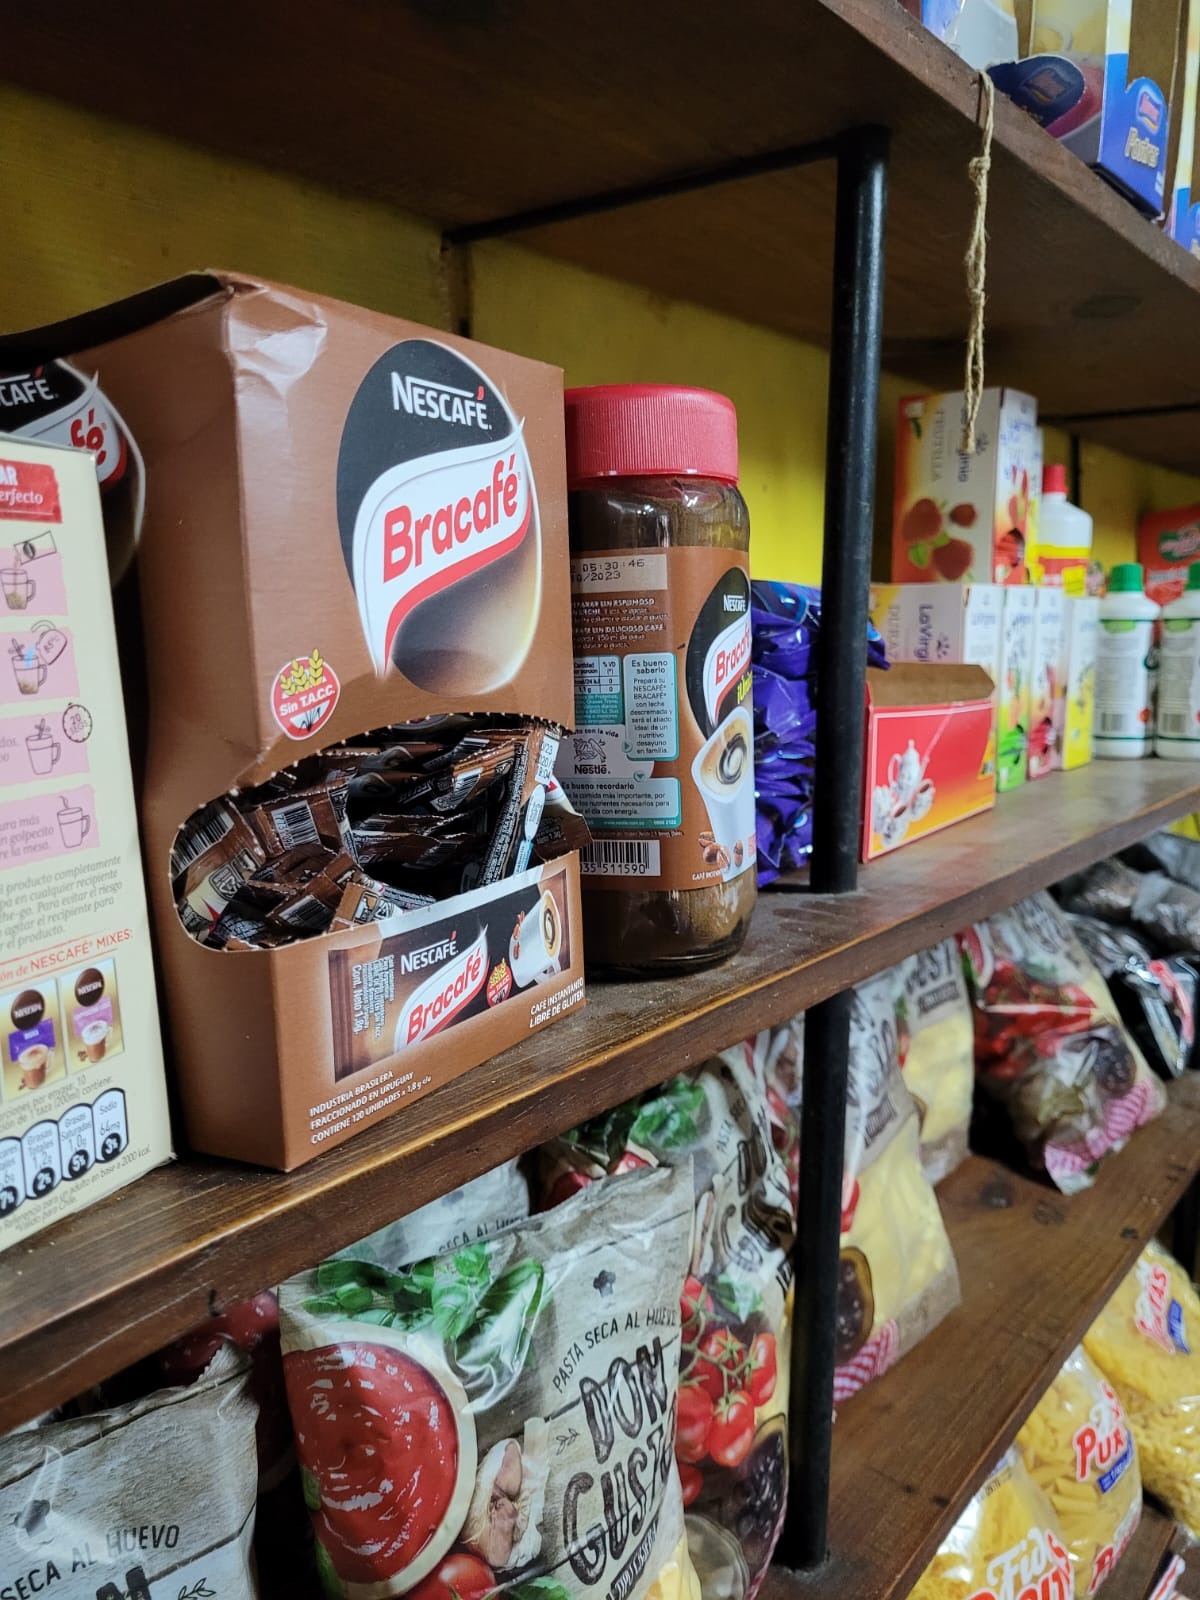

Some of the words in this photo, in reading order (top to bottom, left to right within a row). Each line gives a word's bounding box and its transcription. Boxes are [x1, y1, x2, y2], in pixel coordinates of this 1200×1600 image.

[391, 371, 488, 430] NESCAFÉ
[383, 454, 519, 584] Bracafé
[631, 660, 641, 668] Es
[642, 659, 668, 667] bueno
[636, 666, 666, 675] saberlo
[279, 701, 299, 717] Sin
[571, 782, 594, 790] bueno
[596, 782, 635, 790] recordarlo
[654, 793, 666, 801] por
[601, 808, 614, 816] con
[54, 855, 121, 881] completamente
[602, 863, 646, 875] 511590
[400, 930, 457, 976] NESCAFÉ
[406, 947, 484, 1047] Bracafé
[529, 1011, 551, 1028] LIBRE
[551, 1003, 561, 1016] DE
[561, 988, 585, 1010] GLUTEN
[530, 997, 547, 1016] CAFÉ
[309, 1090, 354, 1117] INDUSTRIA
[355, 1070, 394, 1095] BRASILERA
[310, 1095, 368, 1130] FRACCIONADO
[368, 1088, 379, 1101] EN
[380, 1071, 414, 1095] URUGUAY
[311, 1117, 351, 1144] CONTIENE
[352, 1110, 365, 1123] 120
[365, 1089, 401, 1116] UNIDADES
[552, 1342, 584, 1394] PASTA
[584, 1317, 619, 1350] SECA
[624, 1310, 640, 1331] AL
[579, 1335, 668, 1465] DON
[71, 1541, 99, 1573] AL
[105, 1524, 180, 1558] HUEVO
